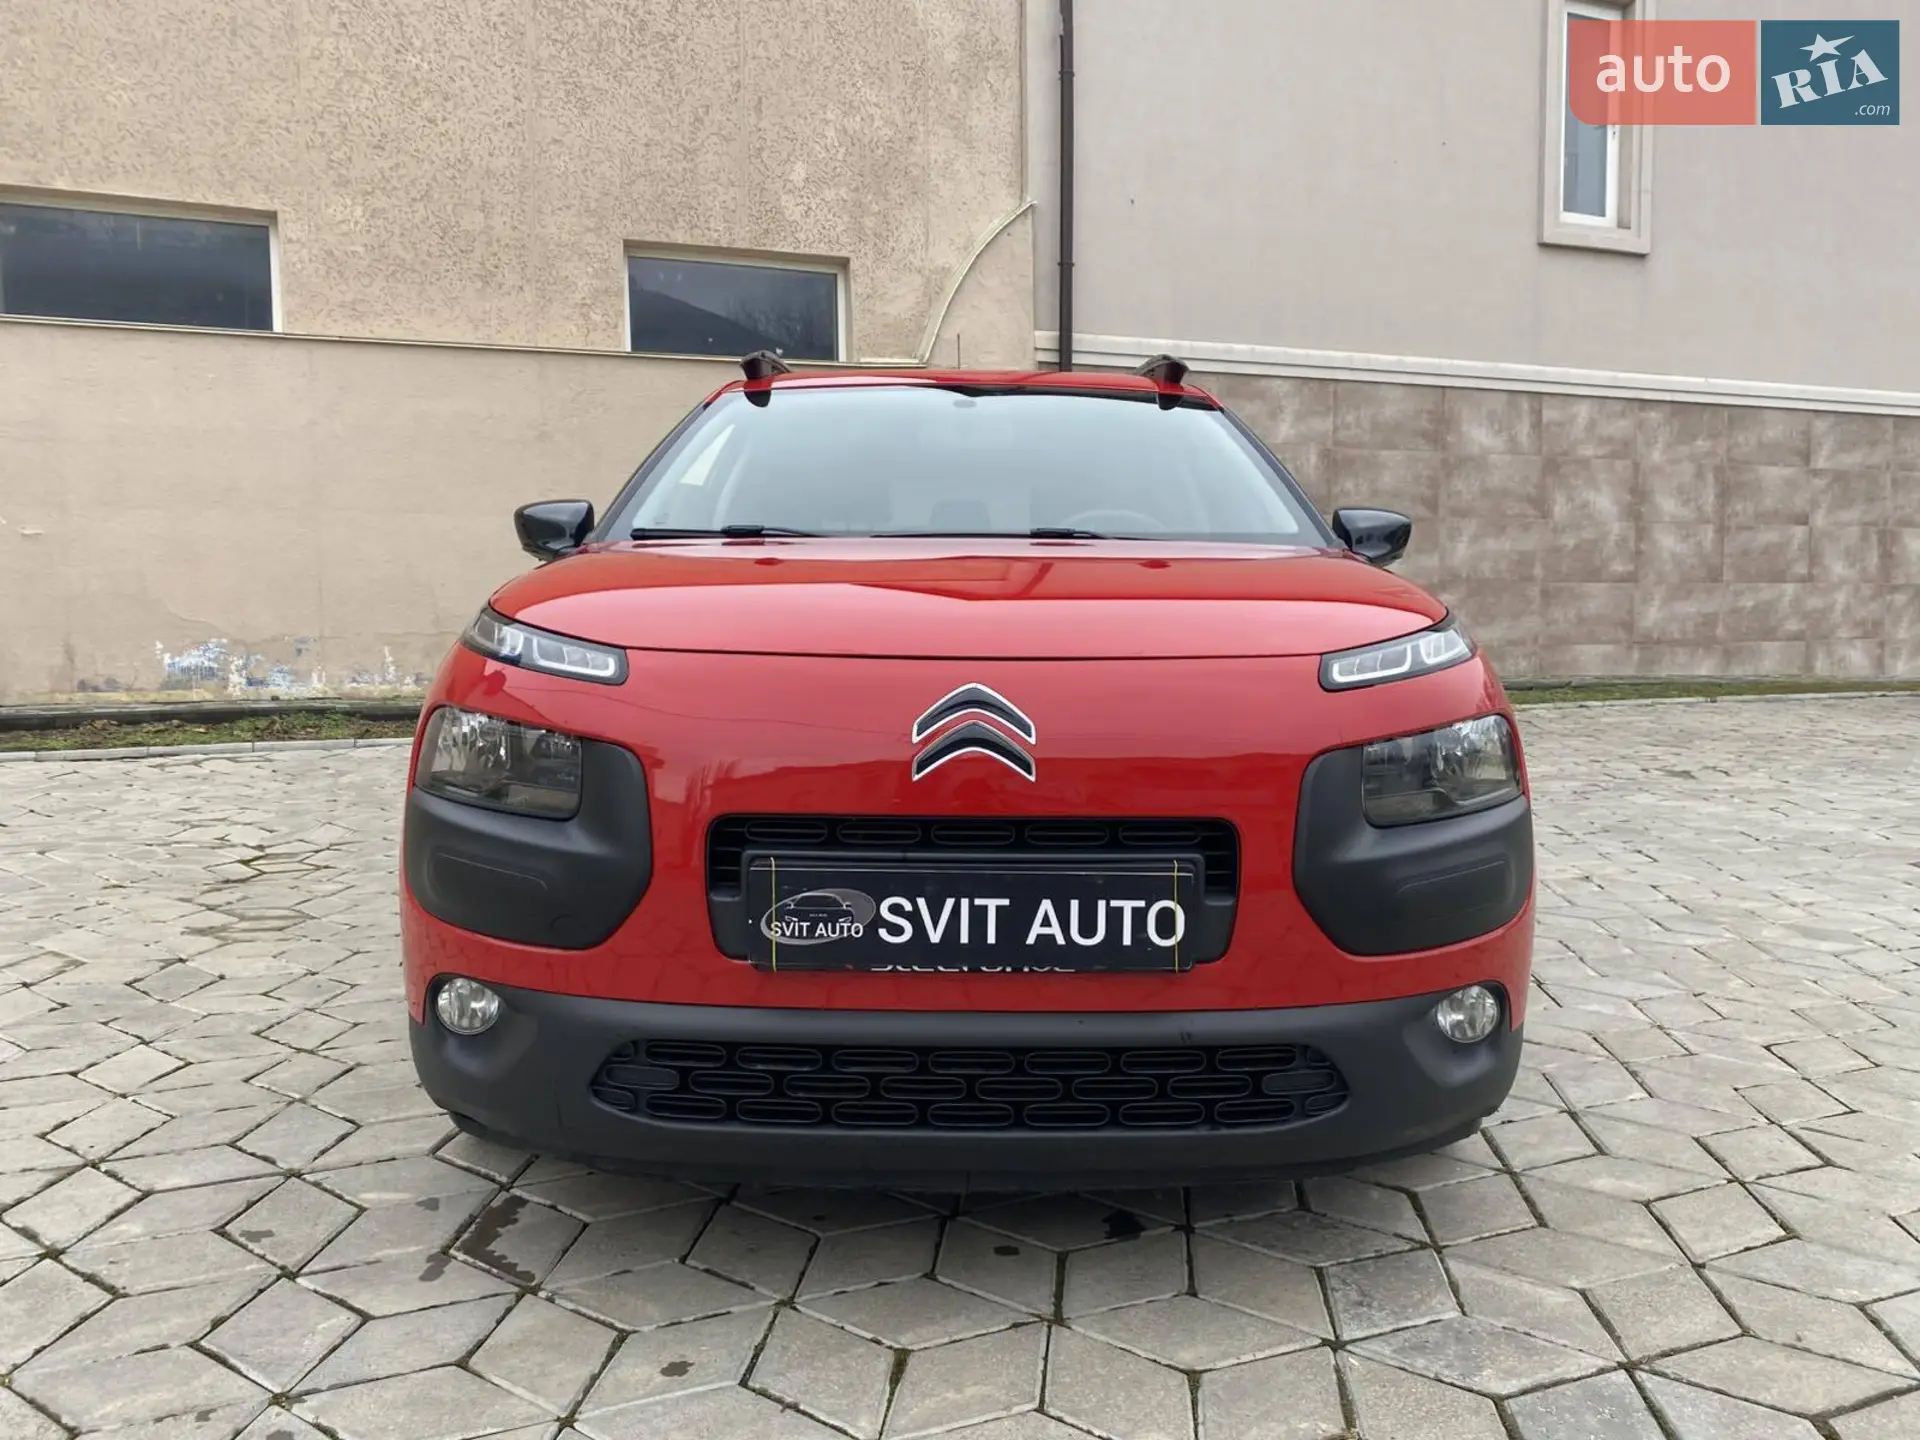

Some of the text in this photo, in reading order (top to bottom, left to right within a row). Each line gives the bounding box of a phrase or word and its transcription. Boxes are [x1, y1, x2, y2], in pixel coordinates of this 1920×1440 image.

[770, 921, 864, 938] SVIT AUTO
[878, 896, 1186, 947] SVIT AUTO
